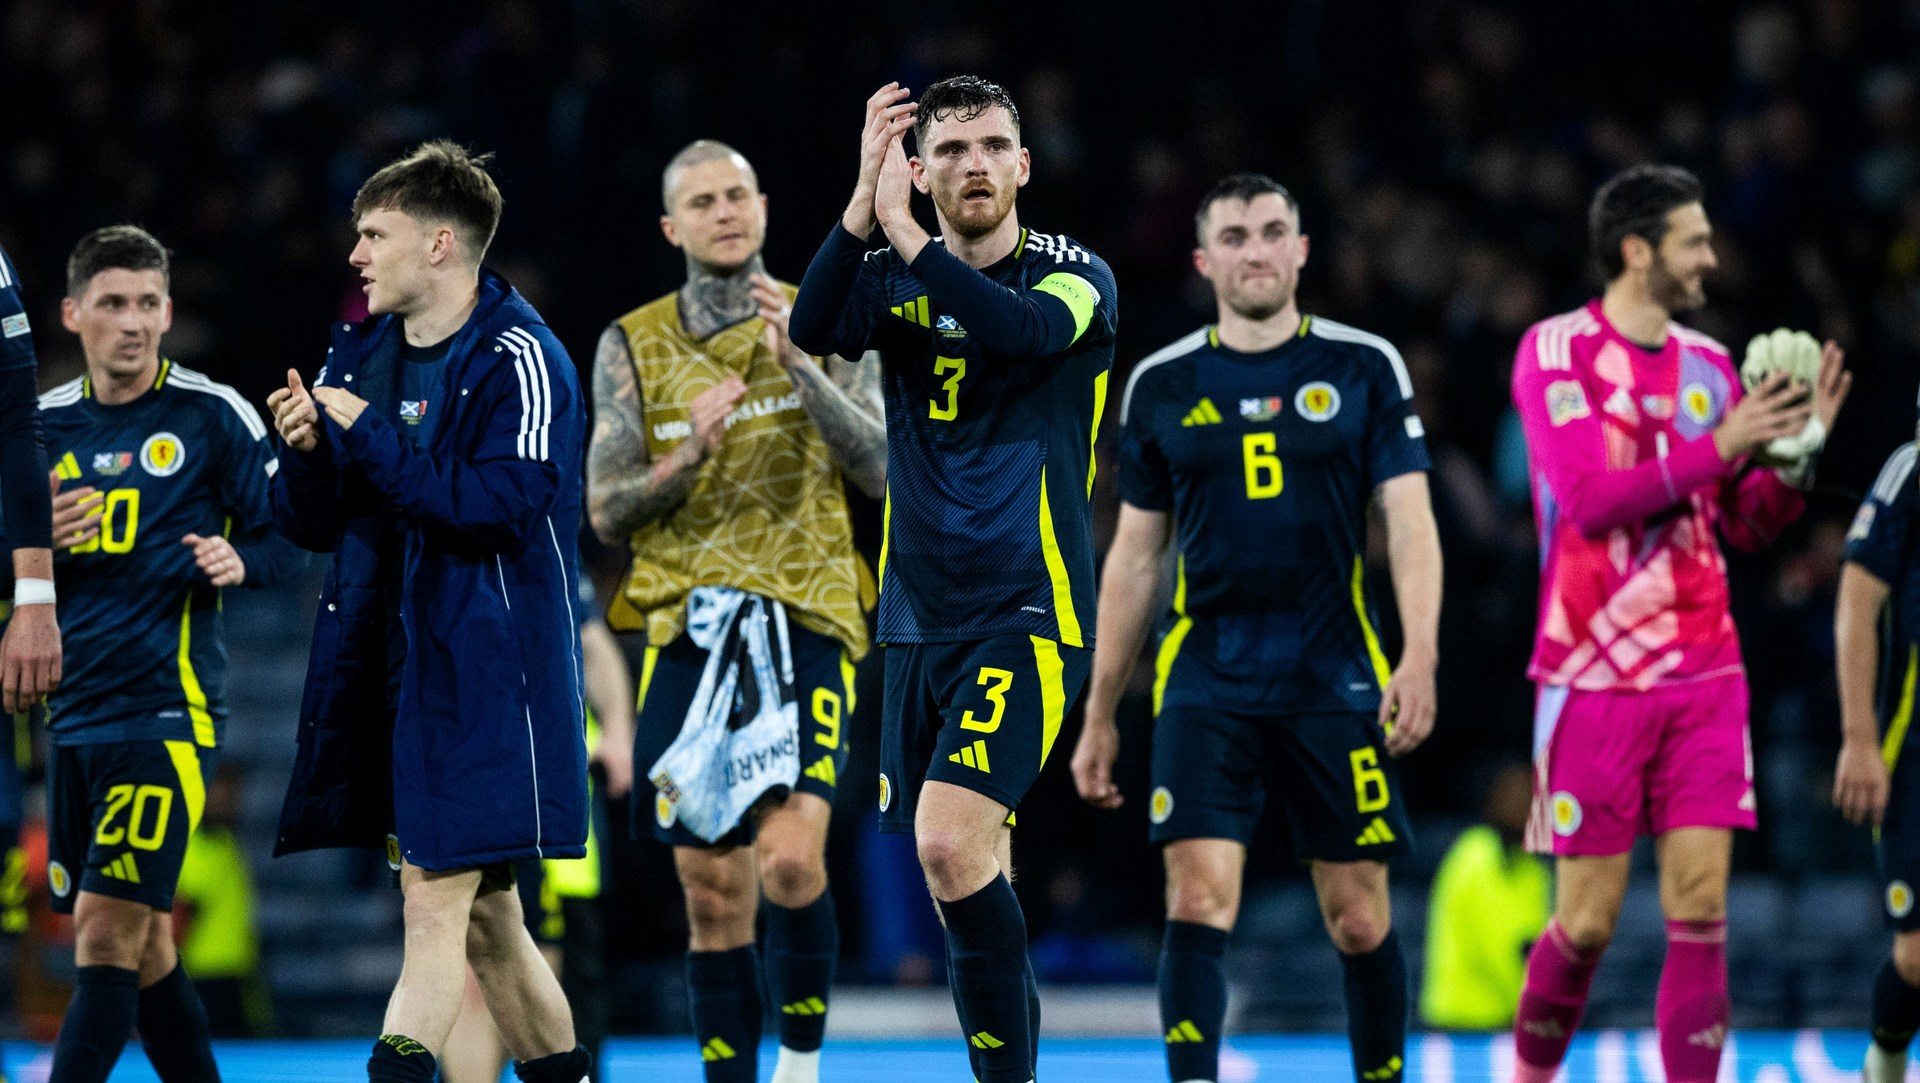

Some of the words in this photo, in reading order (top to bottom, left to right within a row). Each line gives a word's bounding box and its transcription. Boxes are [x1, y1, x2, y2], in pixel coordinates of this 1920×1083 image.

[928, 355, 966, 422] 3
[1242, 432, 1285, 500] 6
[811, 686, 842, 750] 9
[960, 666, 1015, 734] 3
[1349, 745, 1391, 814] 6
[95, 783, 174, 852] 20
